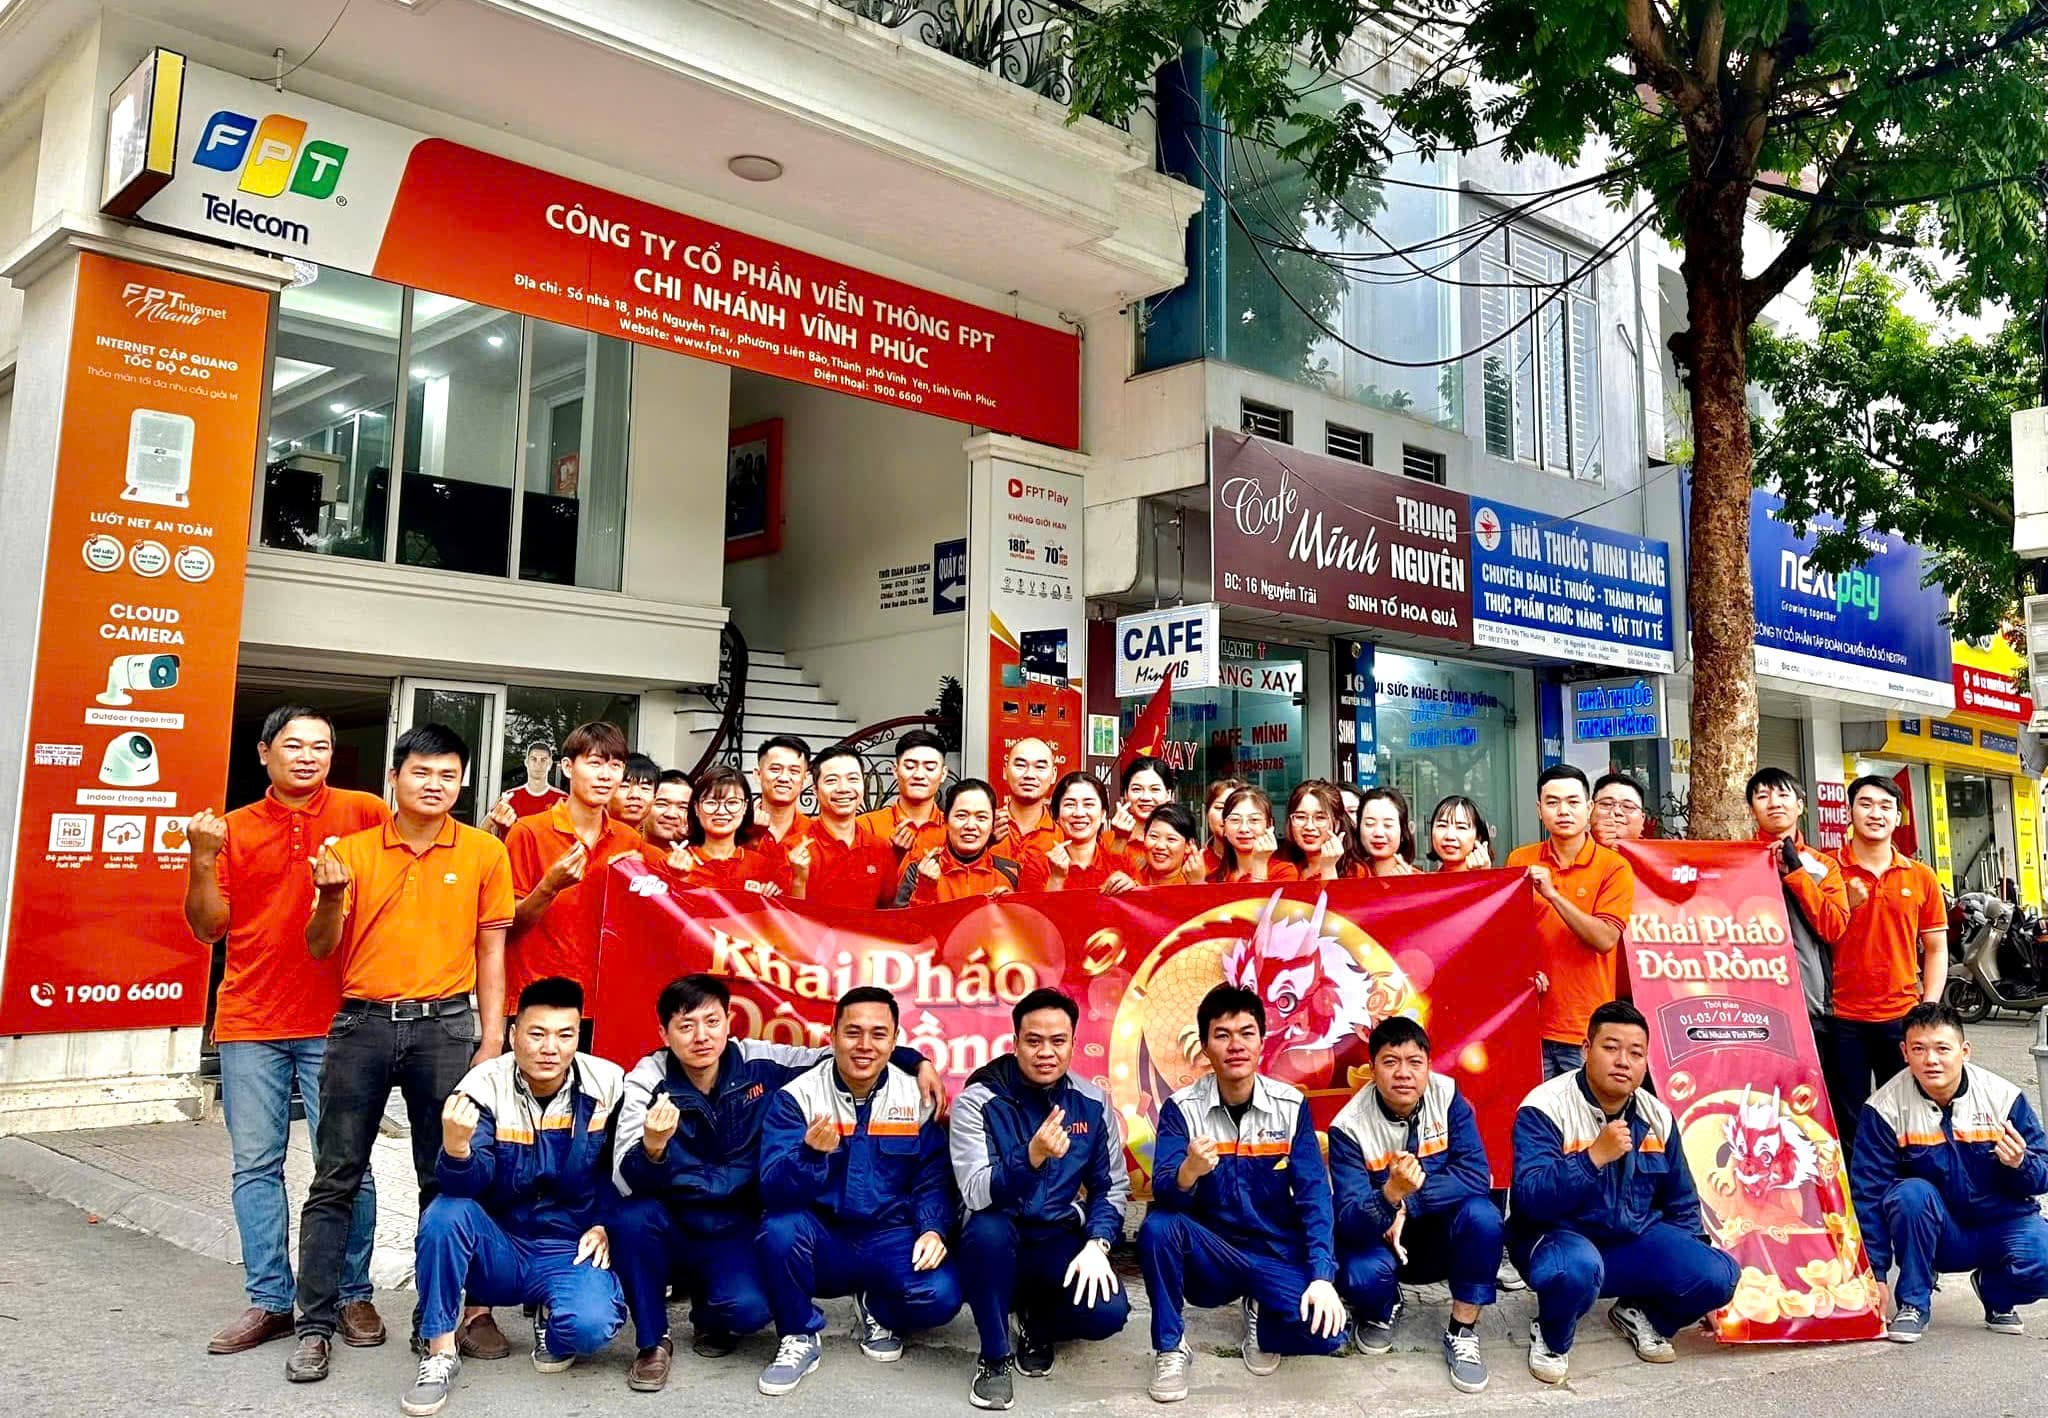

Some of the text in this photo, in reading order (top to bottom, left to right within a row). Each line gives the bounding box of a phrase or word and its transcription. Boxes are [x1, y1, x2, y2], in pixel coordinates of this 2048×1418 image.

[199, 117, 344, 190] FPT
[202, 193, 309, 245] Telecom
[546, 203, 995, 353] CÔNG TY CỔ PHẦN VIỄN THÔNG FPT
[121, 283, 227, 320] FPT Internet
[586, 292, 610, 308] nhà
[634, 268, 928, 369] CHI NHÁNH VĨNH PHÚC
[619, 318, 740, 359] Website: www.fpt.vn
[95, 335, 156, 356] INTERNET
[190, 354, 239, 371] QUANG
[180, 365, 210, 379] CAO
[813, 368, 837, 383] Điện
[1026, 485, 1068, 506] FPT Play
[1221, 469, 1297, 543] Cafe
[90, 511, 213, 537] LƯỚT NET AN TOÀN
[1396, 496, 1457, 543] TRUNG
[1511, 521, 1541, 561] NHÀ
[1544, 526, 1588, 572] THUỐC
[1592, 542, 1627, 580] MINH
[1391, 543, 1465, 592] NGUYÊN
[1224, 573, 1242, 591] ĐC:
[1245, 577, 1258, 593] 16
[1482, 564, 1523, 588] CHUYÊN
[1526, 566, 1548, 593] BÁN
[1564, 577, 1595, 603] THUỐC
[1604, 587, 1634, 610] THÀNH
[110, 603, 180, 623] CLOUD
[1347, 594, 1458, 628] SINH TỐ HOA QUẢ
[1484, 592, 1512, 615] THỰC
[1547, 602, 1574, 626] CHỨC
[1576, 608, 1604, 632] NĂNG
[1612, 614, 1630, 641] VẬT
[1645, 624, 1652, 639] Y
[1652, 619, 1664, 641] TẾ
[1781, 600, 1837, 622] Growing together
[100, 624, 185, 645] CAMERA
[1123, 618, 1203, 661] CAFE
[1175, 660, 1190, 678] 16
[1219, 664, 1297, 692] ANG XAY
[1344, 672, 1365, 693] 16
[1387, 680, 1409, 697] SỨC
[91, 712, 127, 722] Outdoor
[1212, 728, 1242, 747] CAFE
[1338, 719, 1355, 744] SINH
[1161, 740, 1199, 771] XAY
[1343, 753, 1352, 783] TỐ
[87, 793, 115, 802] Indoor
[1817, 784, 1845, 802] CHO
[1817, 804, 1847, 825] THUÊ
[62, 828, 81, 837] HD
[1629, 913, 1786, 946] Khai Pháo
[707, 927, 1038, 1007] Khai Pháo
[1636, 946, 1791, 986] Đón Rồng
[65, 982, 183, 1003] 1900 6600
